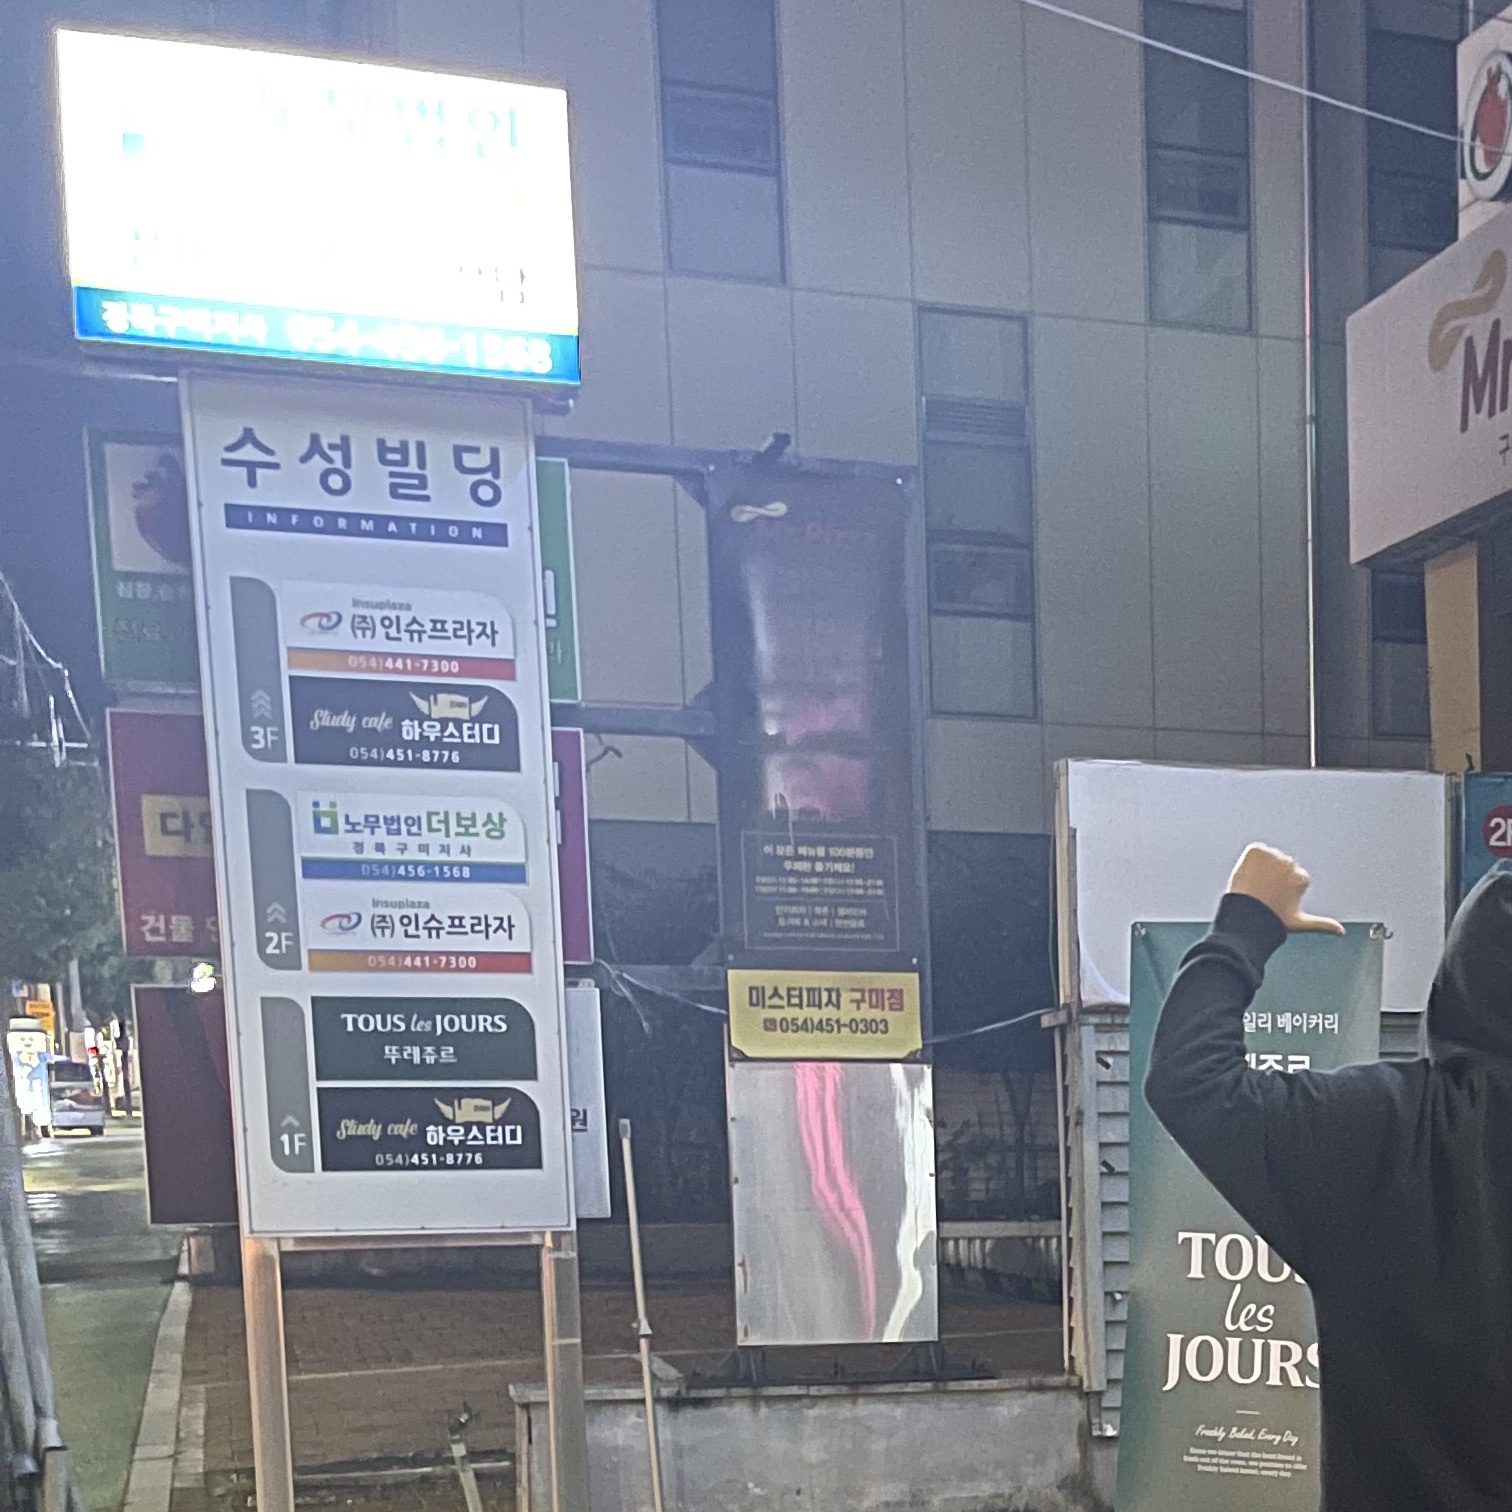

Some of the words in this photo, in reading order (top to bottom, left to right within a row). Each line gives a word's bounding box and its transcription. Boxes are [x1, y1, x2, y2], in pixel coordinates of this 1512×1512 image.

[221, 427, 502, 507] 수성빌딩
[247, 511, 483, 540] INFORMATION
[347, 654, 460, 673] 054)441-7300
[310, 708, 357, 733] Study
[401, 720, 500, 744] 하우스터디
[250, 726, 279, 750] 3F
[349, 747, 460, 763] 054)451-8776
[344, 813, 422, 837] 노무법인
[426, 810, 508, 840] 더보상
[361, 863, 471, 879] 054)456-1568
[264, 931, 294, 955] 2F
[367, 954, 477, 969] 054)441-7300
[748, 985, 842, 1011] 미스터피자
[848, 987, 904, 1012] 구미점
[340, 1013, 406, 1033] TOUS
[410, 1013, 432, 1033] les
[435, 1014, 508, 1036] JOURS
[779, 1016, 889, 1035] 054)451-0303
[1277, 1012, 1339, 1035] 베이커리
[383, 1045, 458, 1065] 뚜레쥬르
[336, 1118, 383, 1142] Study
[425, 1124, 522, 1146] 하우스터디
[279, 1133, 307, 1156] 1F
[375, 1152, 483, 1167] 054)451-8776
[1178, 1232, 1306, 1284] TOU
[1225, 1283, 1275, 1332] les
